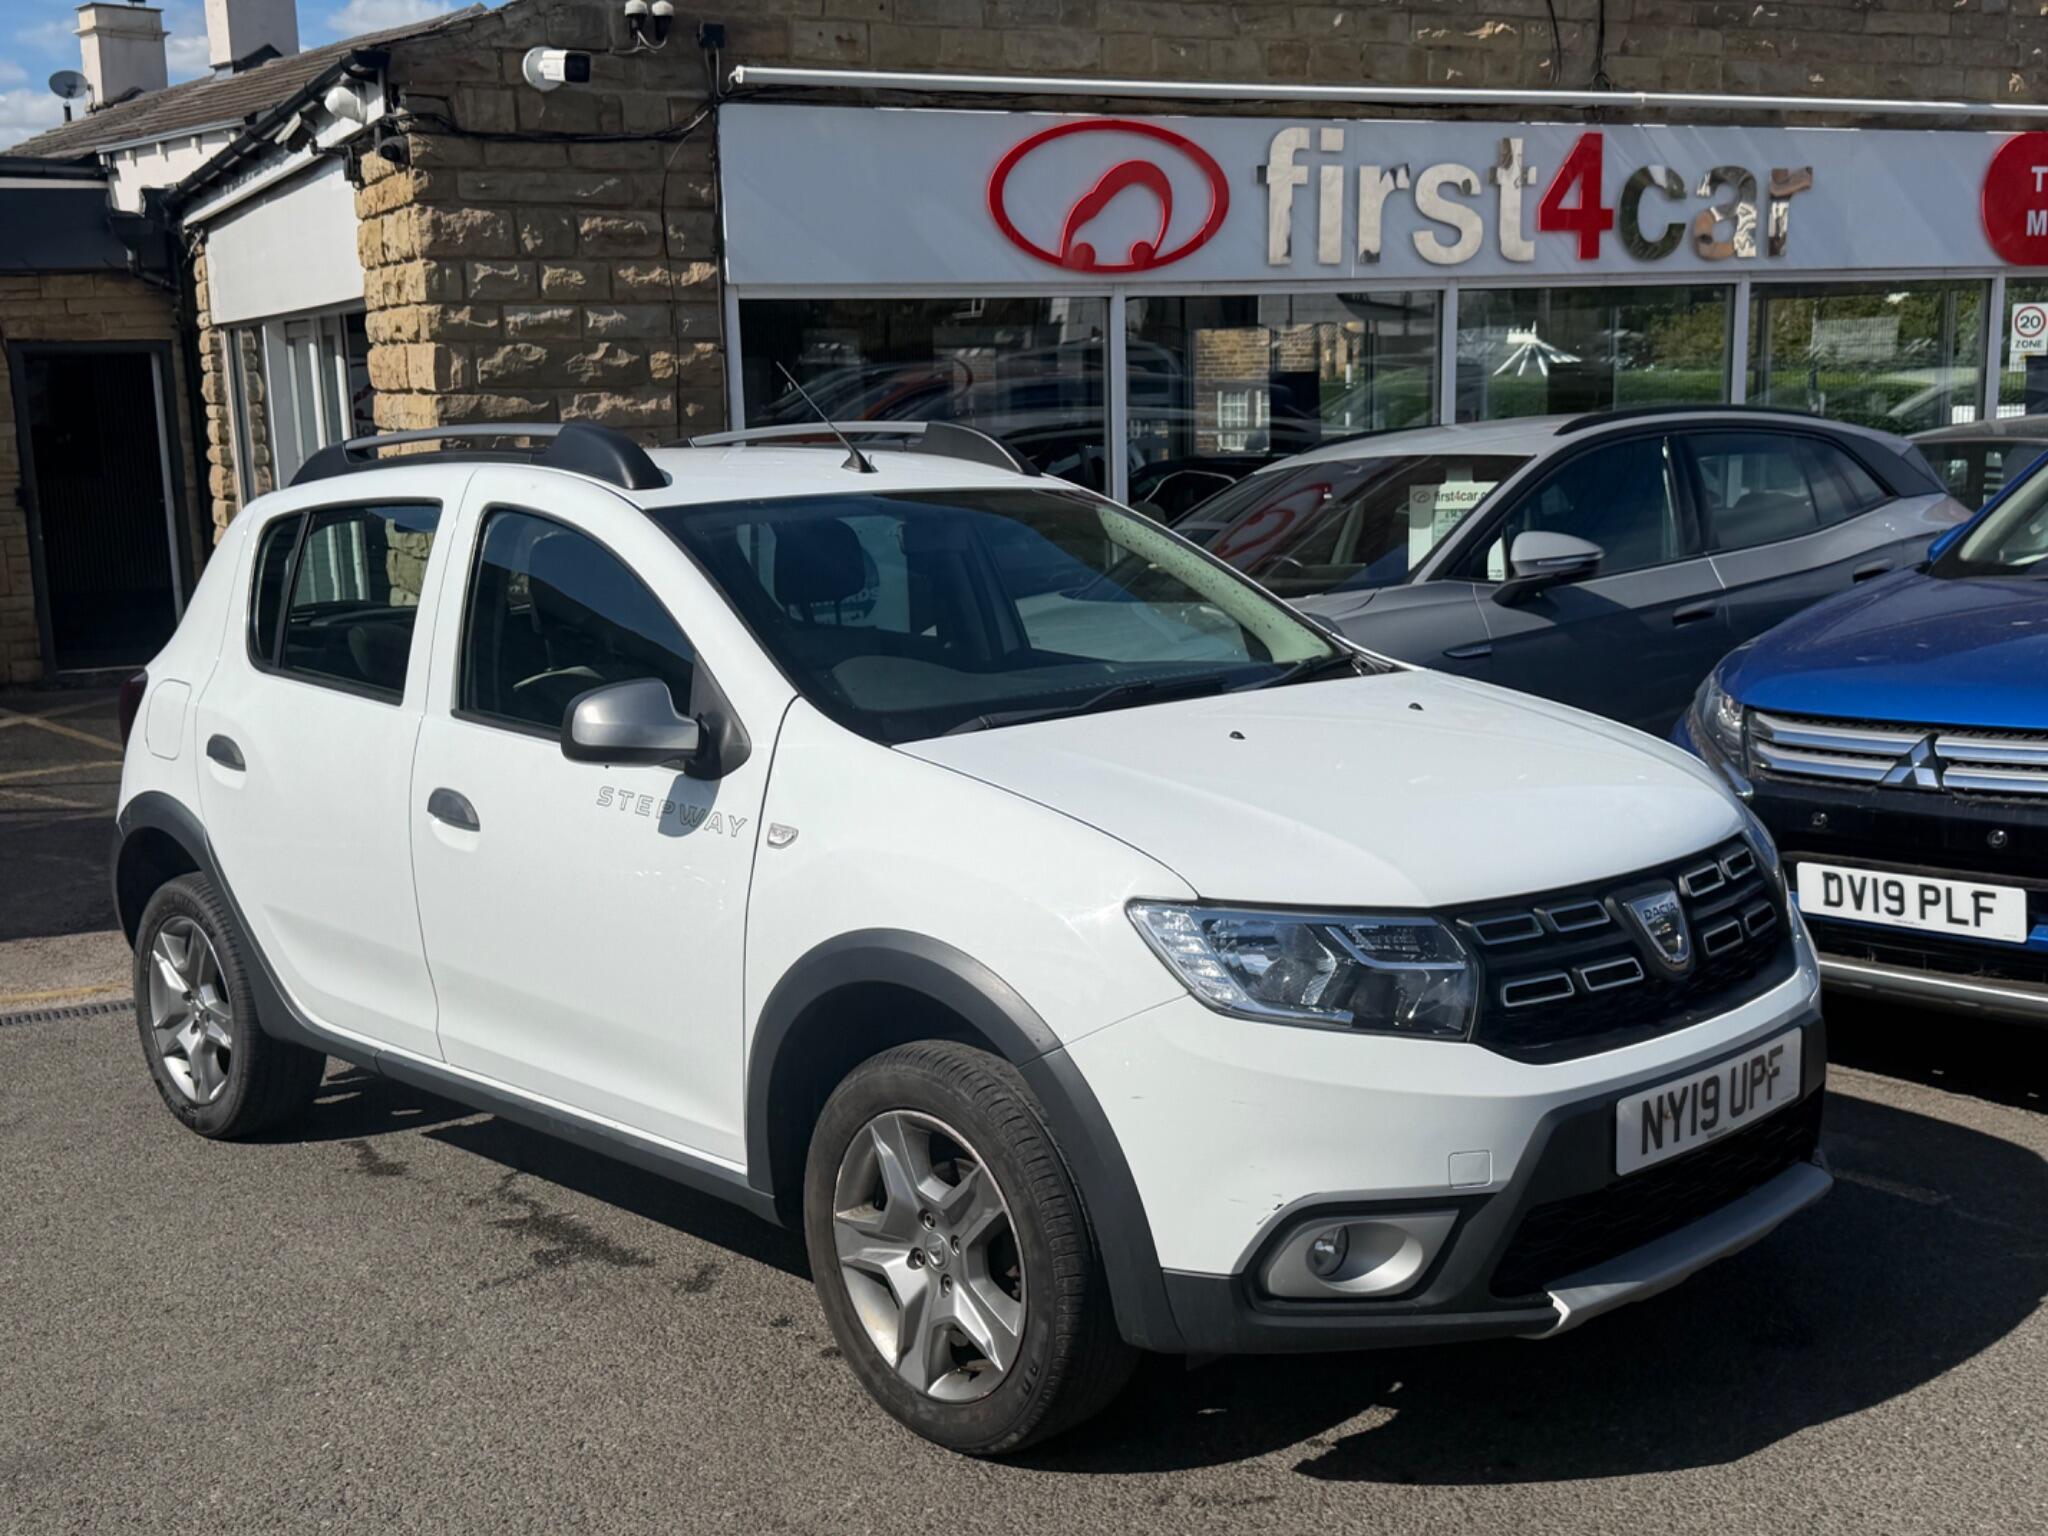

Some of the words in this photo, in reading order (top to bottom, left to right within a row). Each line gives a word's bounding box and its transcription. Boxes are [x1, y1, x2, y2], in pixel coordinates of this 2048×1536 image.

[1256, 127, 1813, 266] first4car
[2015, 340, 2043, 349] ZONE
[2020, 315, 2041, 329] 20
[596, 785, 748, 838] STEPWAY
[1643, 901, 1678, 921] DACIA
[1822, 871, 1906, 917] DV19
[1918, 883, 1997, 928] PLF
[1641, 1074, 1721, 1156] NY19
[1729, 1044, 1784, 1120] UPF
